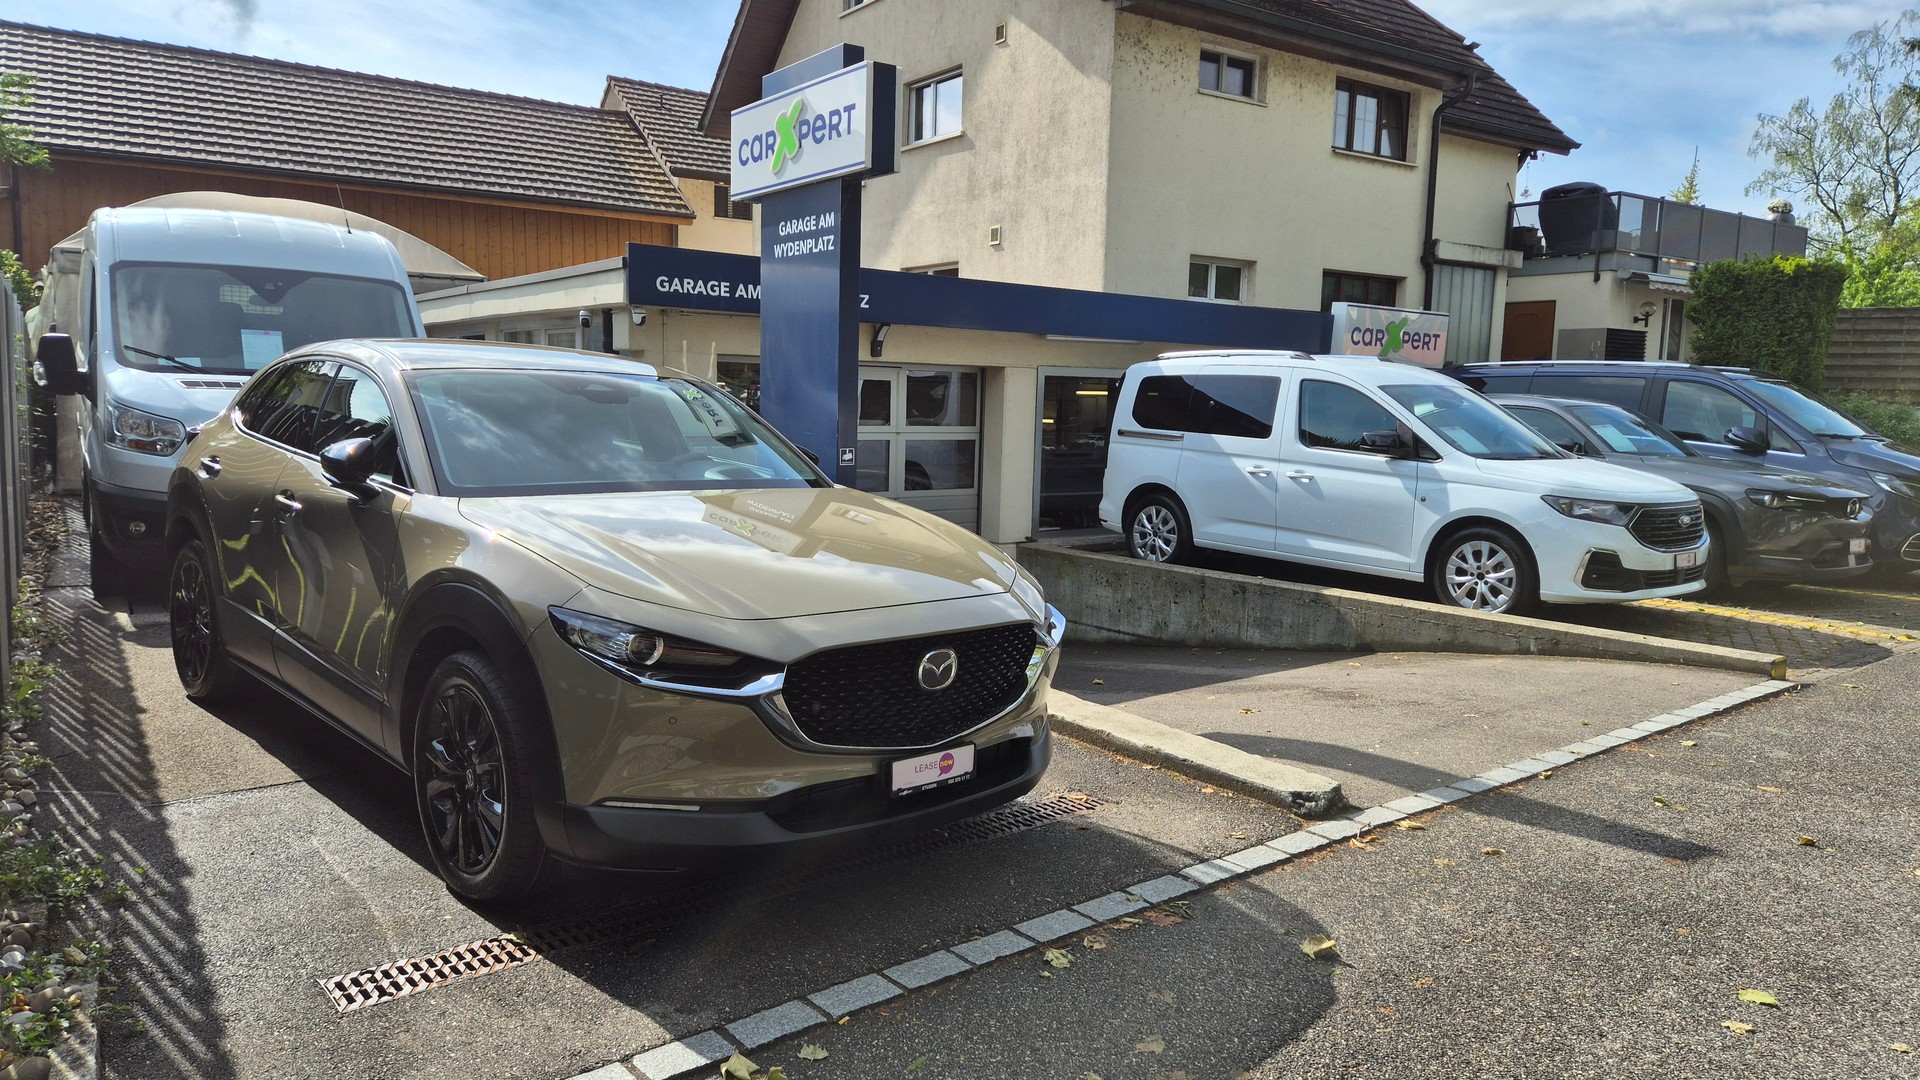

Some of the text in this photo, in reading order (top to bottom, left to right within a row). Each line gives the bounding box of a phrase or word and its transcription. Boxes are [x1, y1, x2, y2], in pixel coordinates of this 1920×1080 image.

[779, 211, 835, 236] GARAGE AM
[774, 235, 835, 259] WYDENPLATZ
[656, 276, 761, 300] GARAGE AM
[914, 759, 953, 773] LEASE now
